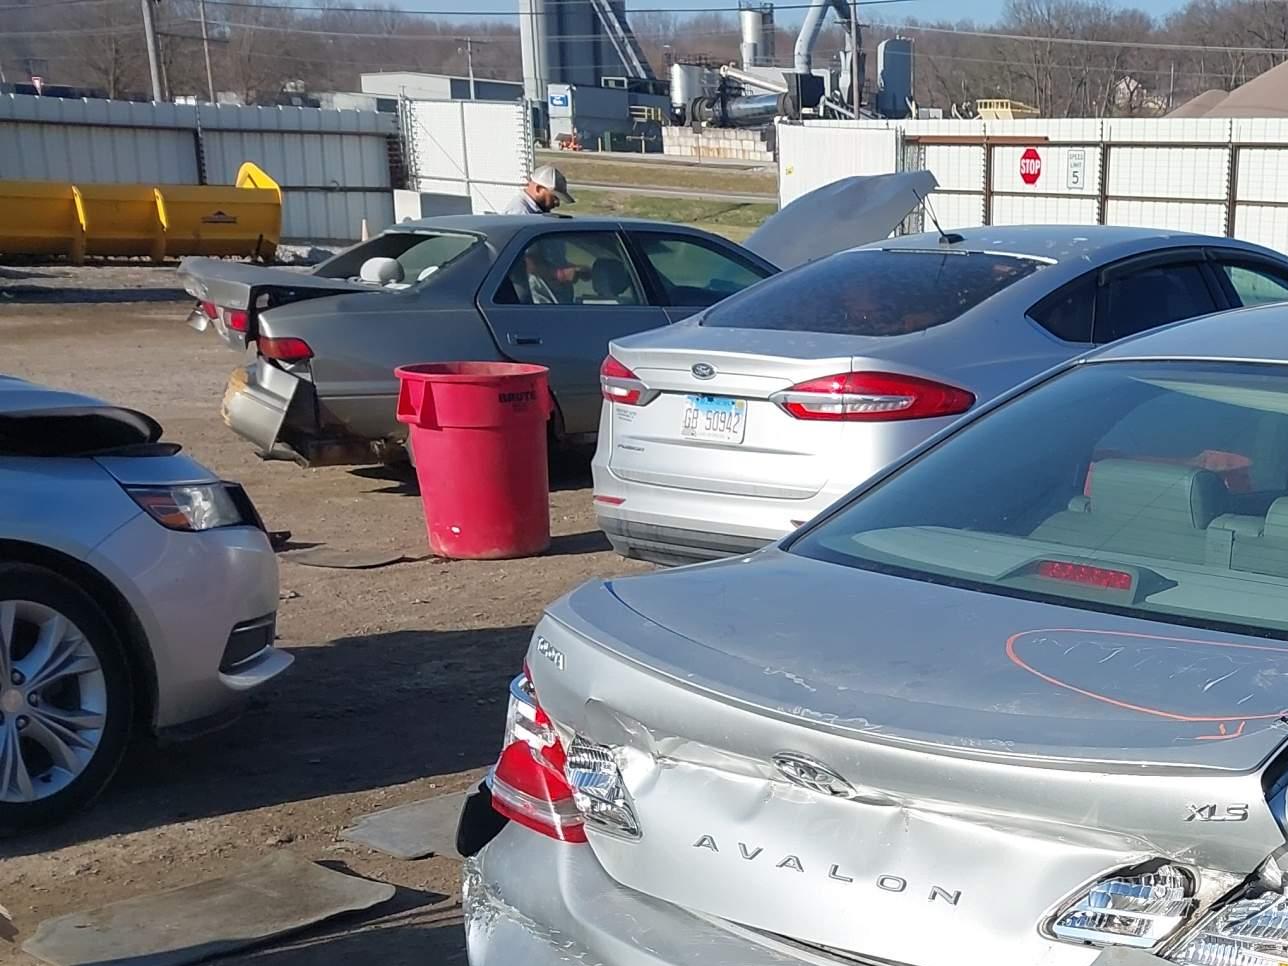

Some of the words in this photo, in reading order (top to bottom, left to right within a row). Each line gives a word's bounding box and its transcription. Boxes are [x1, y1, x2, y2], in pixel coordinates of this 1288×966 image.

[1021, 159, 1040, 174] STOP
[1072, 171, 1079, 184] 5
[499, 391, 536, 403] BRUTE
[684, 407, 699, 429] GB
[705, 410, 741, 434] 50942
[1184, 803, 1249, 822] XLS
[692, 834, 962, 906] AVALON
